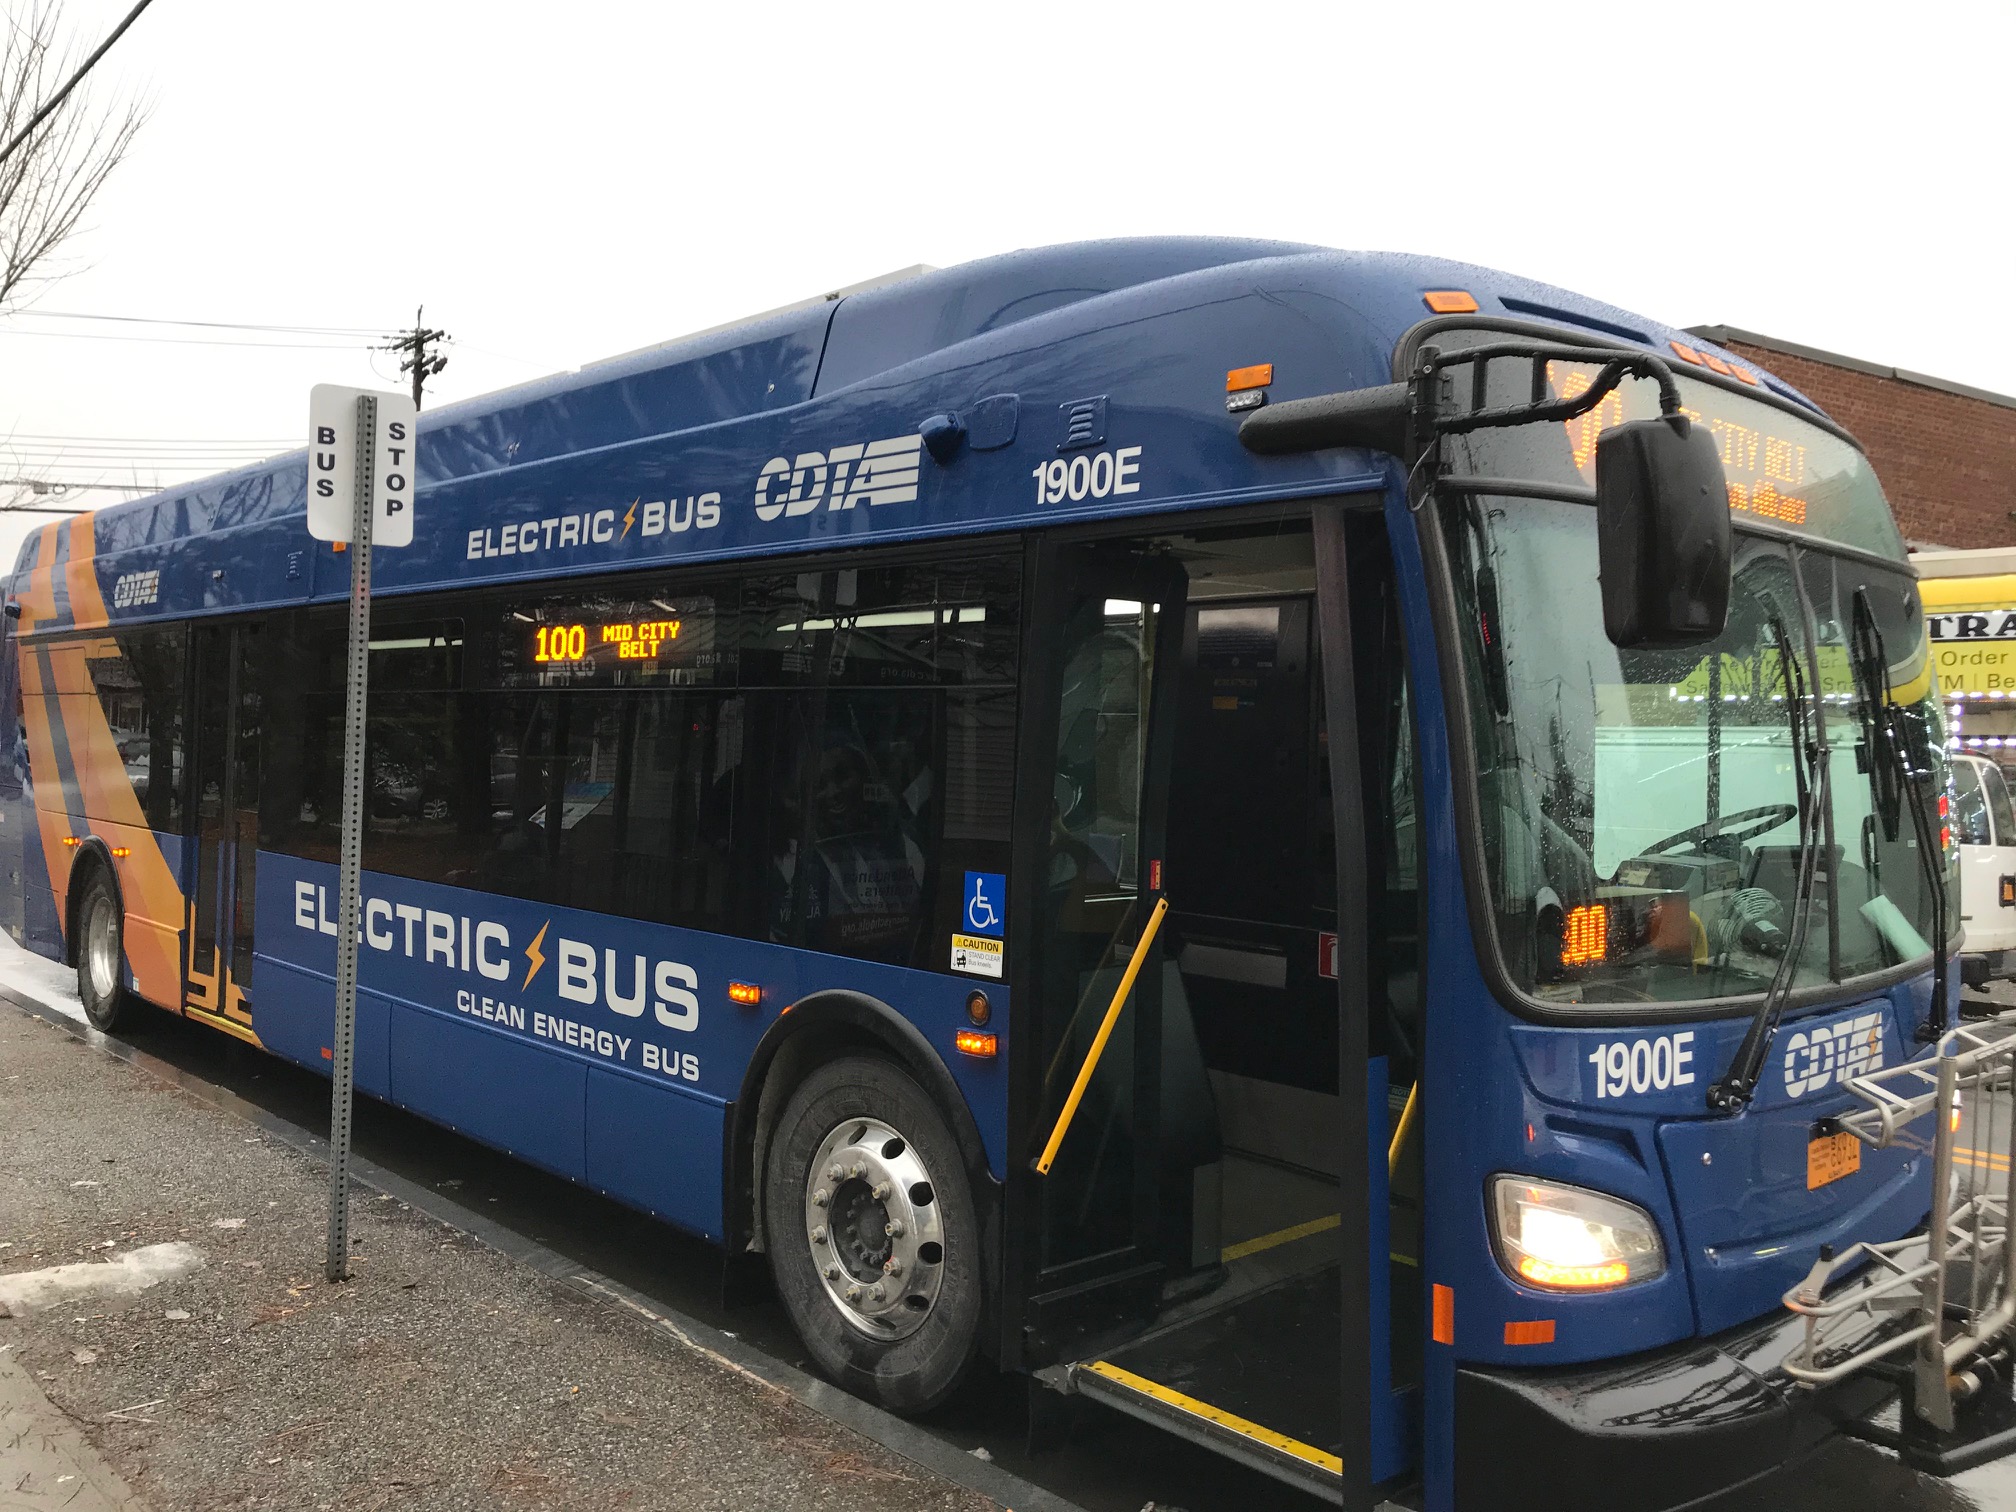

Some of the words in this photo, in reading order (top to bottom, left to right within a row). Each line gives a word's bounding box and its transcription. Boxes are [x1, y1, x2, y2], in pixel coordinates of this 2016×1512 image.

[317, 426, 336, 498] BUS
[386, 422, 407, 517] STOP
[754, 433, 922, 523] CDTA
[1032, 445, 1142, 506] 1900E
[466, 514, 614, 560] ELECTRIC
[641, 491, 721, 537] BUS
[114, 569, 160, 609] CDTA
[535, 625, 586, 662] 100
[602, 622, 633, 643] MID
[639, 620, 681, 641] CITY
[619, 640, 660, 659] BELT
[1941, 649, 2009, 667] Order
[294, 880, 511, 982] ELCTRIC
[558, 938, 700, 1034] BUS
[963, 938, 999, 953] CAUTION
[968, 951, 985, 960] STAND
[985, 954, 1001, 963] CLEAR
[457, 989, 526, 1031] CLEAN
[533, 1011, 632, 1061] ENERGY
[642, 1042, 700, 1083] BUS
[1588, 1031, 1695, 1099] 1900E
[1785, 1011, 1884, 1099] CDTA
